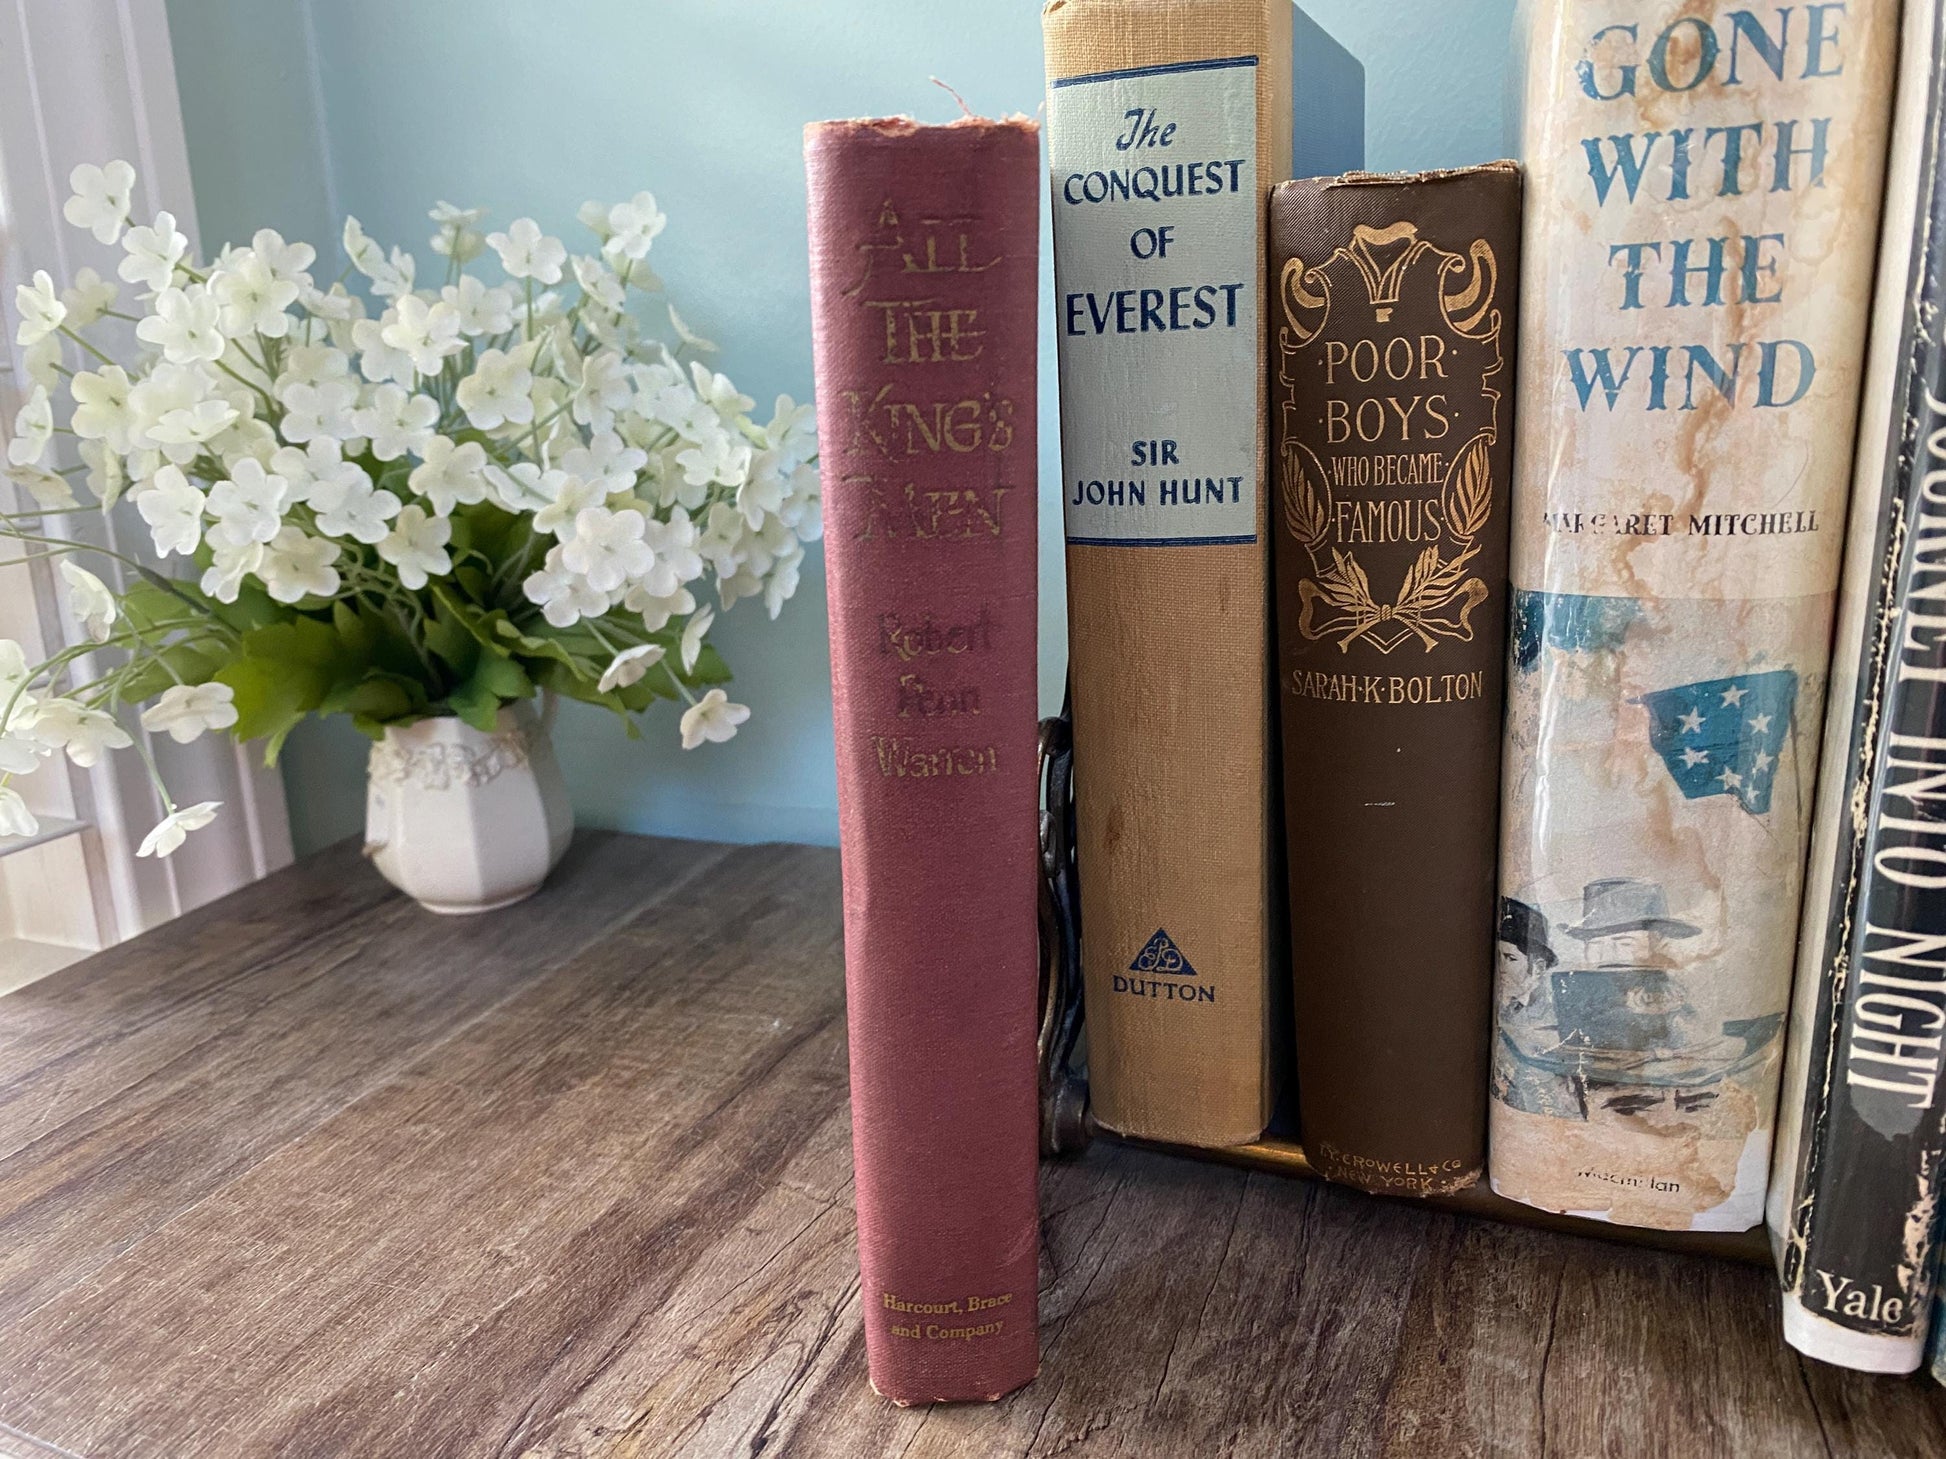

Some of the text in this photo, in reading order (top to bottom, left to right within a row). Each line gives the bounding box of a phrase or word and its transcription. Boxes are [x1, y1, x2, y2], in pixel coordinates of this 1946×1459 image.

[1575, 3, 1846, 101] GONE
[1115, 107, 1177, 150] The
[1063, 159, 1246, 205] CONQUEST
[1580, 117, 1832, 207] WITH
[841, 200, 1003, 296] ALL
[1130, 225, 1175, 259] OF
[1608, 233, 1786, 310] THE
[860, 300, 987, 363] THE
[1066, 283, 1245, 336] EVEREST
[1325, 335, 1448, 384] POOR
[1561, 339, 1816, 412] WIND
[840, 384, 1014, 462] KING'S
[1326, 395, 1449, 443] BOYS
[1131, 440, 1179, 466] SIR
[1331, 453, 1444, 486] WHO BECAME
[1072, 475, 1244, 506] JOHN HUNT
[1334, 499, 1441, 543] FAMOUS
[1688, 510, 1819, 536] MITCHELL
[1113, 974, 1216, 1003] DUTTON
[1846, 920, 1946, 1110] NIGHT
[883, 1293, 1013, 1315] Harcourt, Brace
[1817, 1269, 1904, 1325] Yale
[891, 1321, 1004, 1341] and Company
